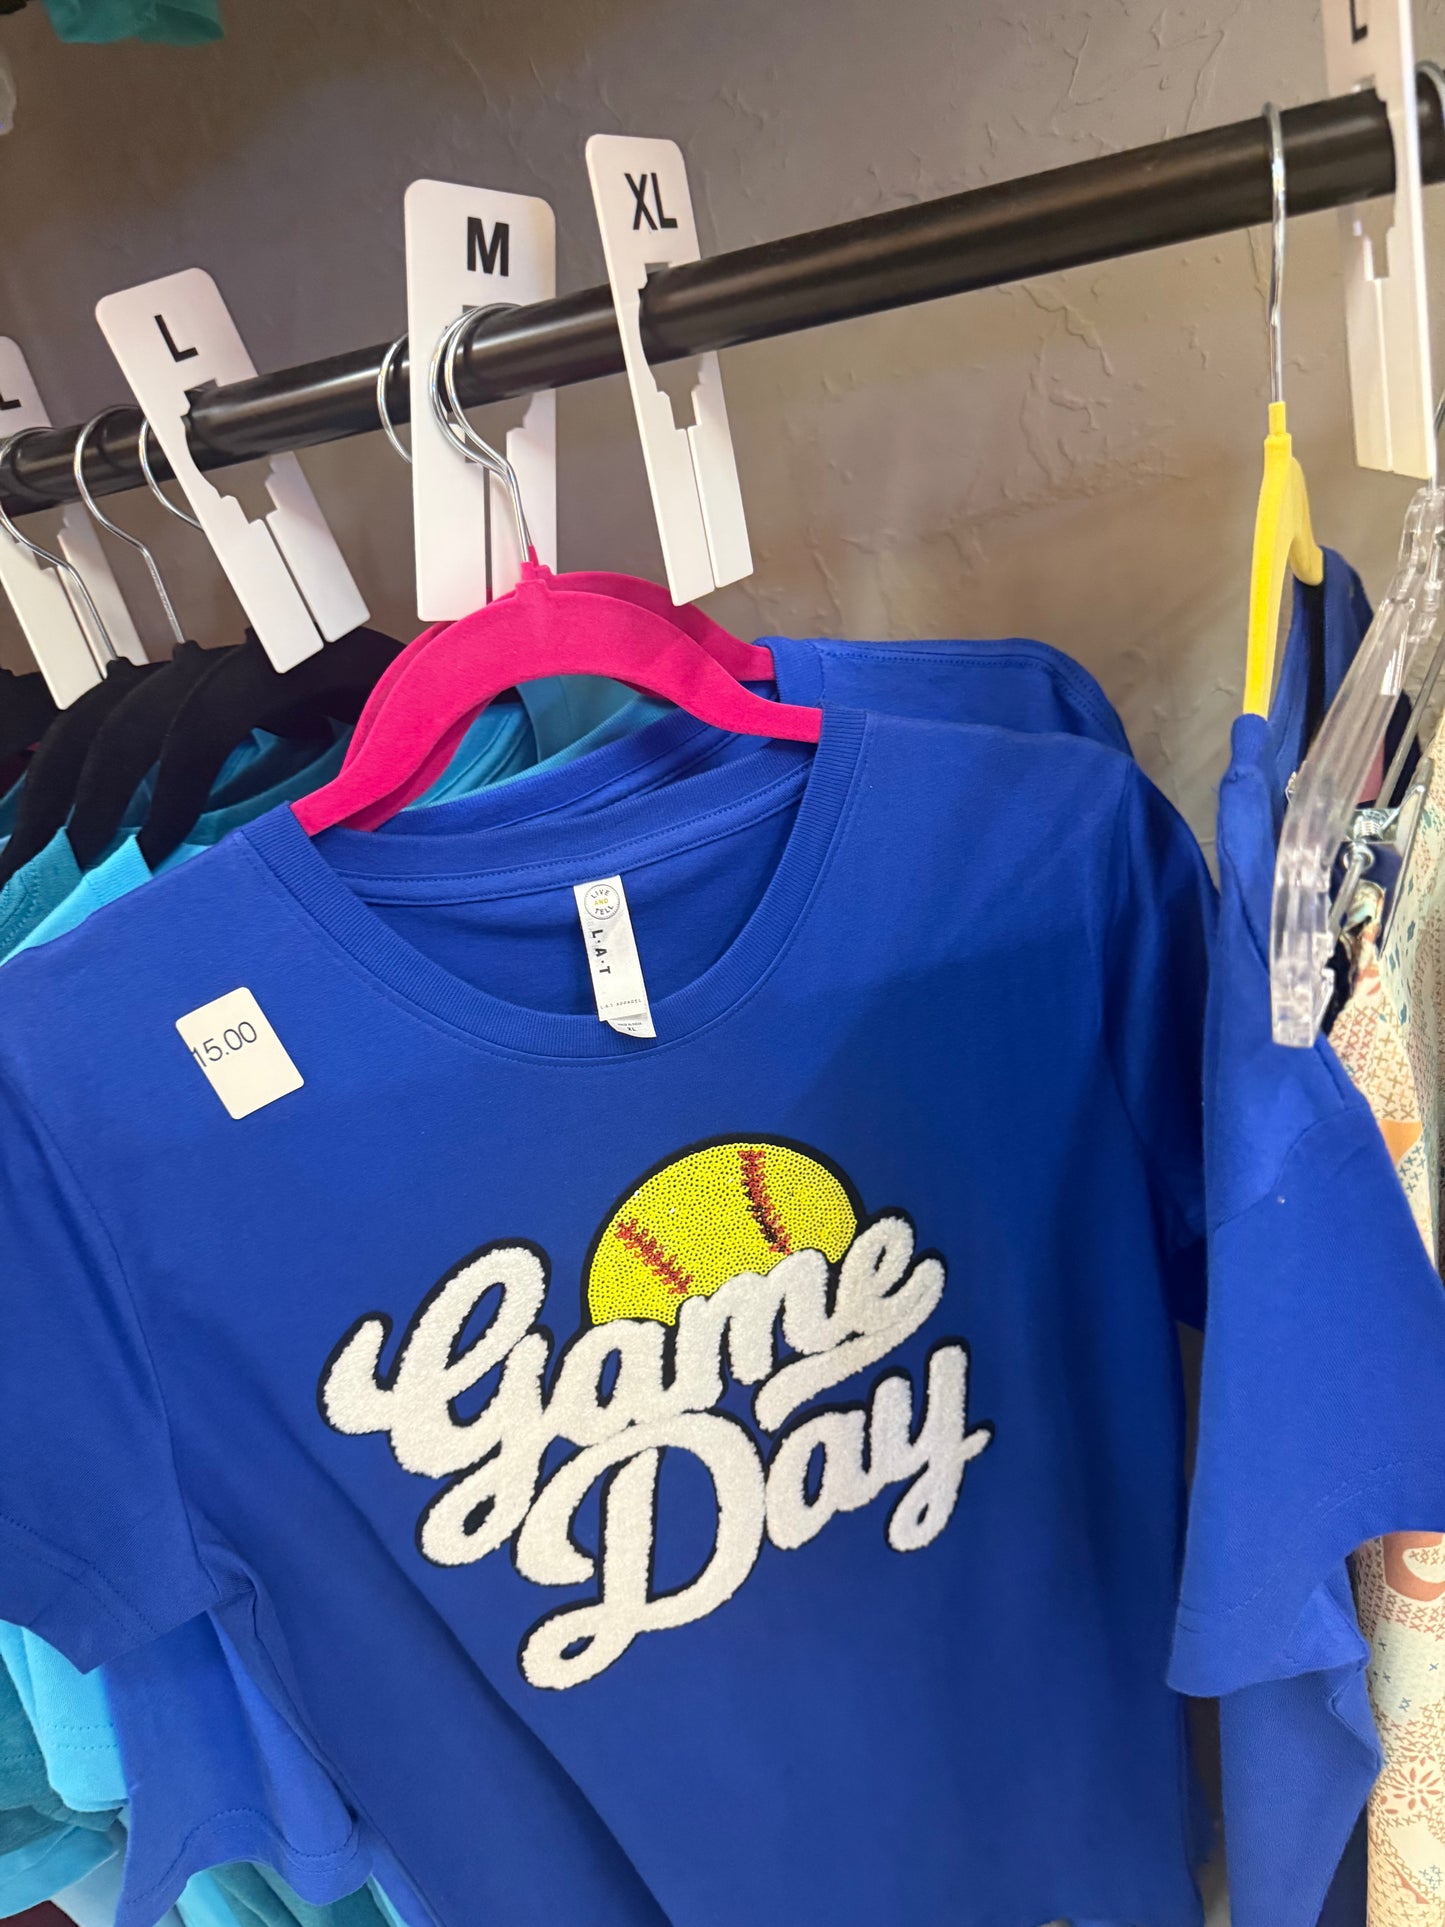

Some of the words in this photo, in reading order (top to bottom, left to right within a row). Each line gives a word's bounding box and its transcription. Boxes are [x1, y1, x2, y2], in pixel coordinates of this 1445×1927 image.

[623, 172, 679, 232] XL
[466, 216, 511, 278] M
[153, 313, 199, 363] L
[590, 889, 611, 899] LIVE
[594, 898, 609, 906] AND
[594, 904, 614, 916] TELL
[192, 1021, 258, 1068] 15.00
[322, 1215, 946, 1567] Game
[515, 1345, 992, 1690] Day
